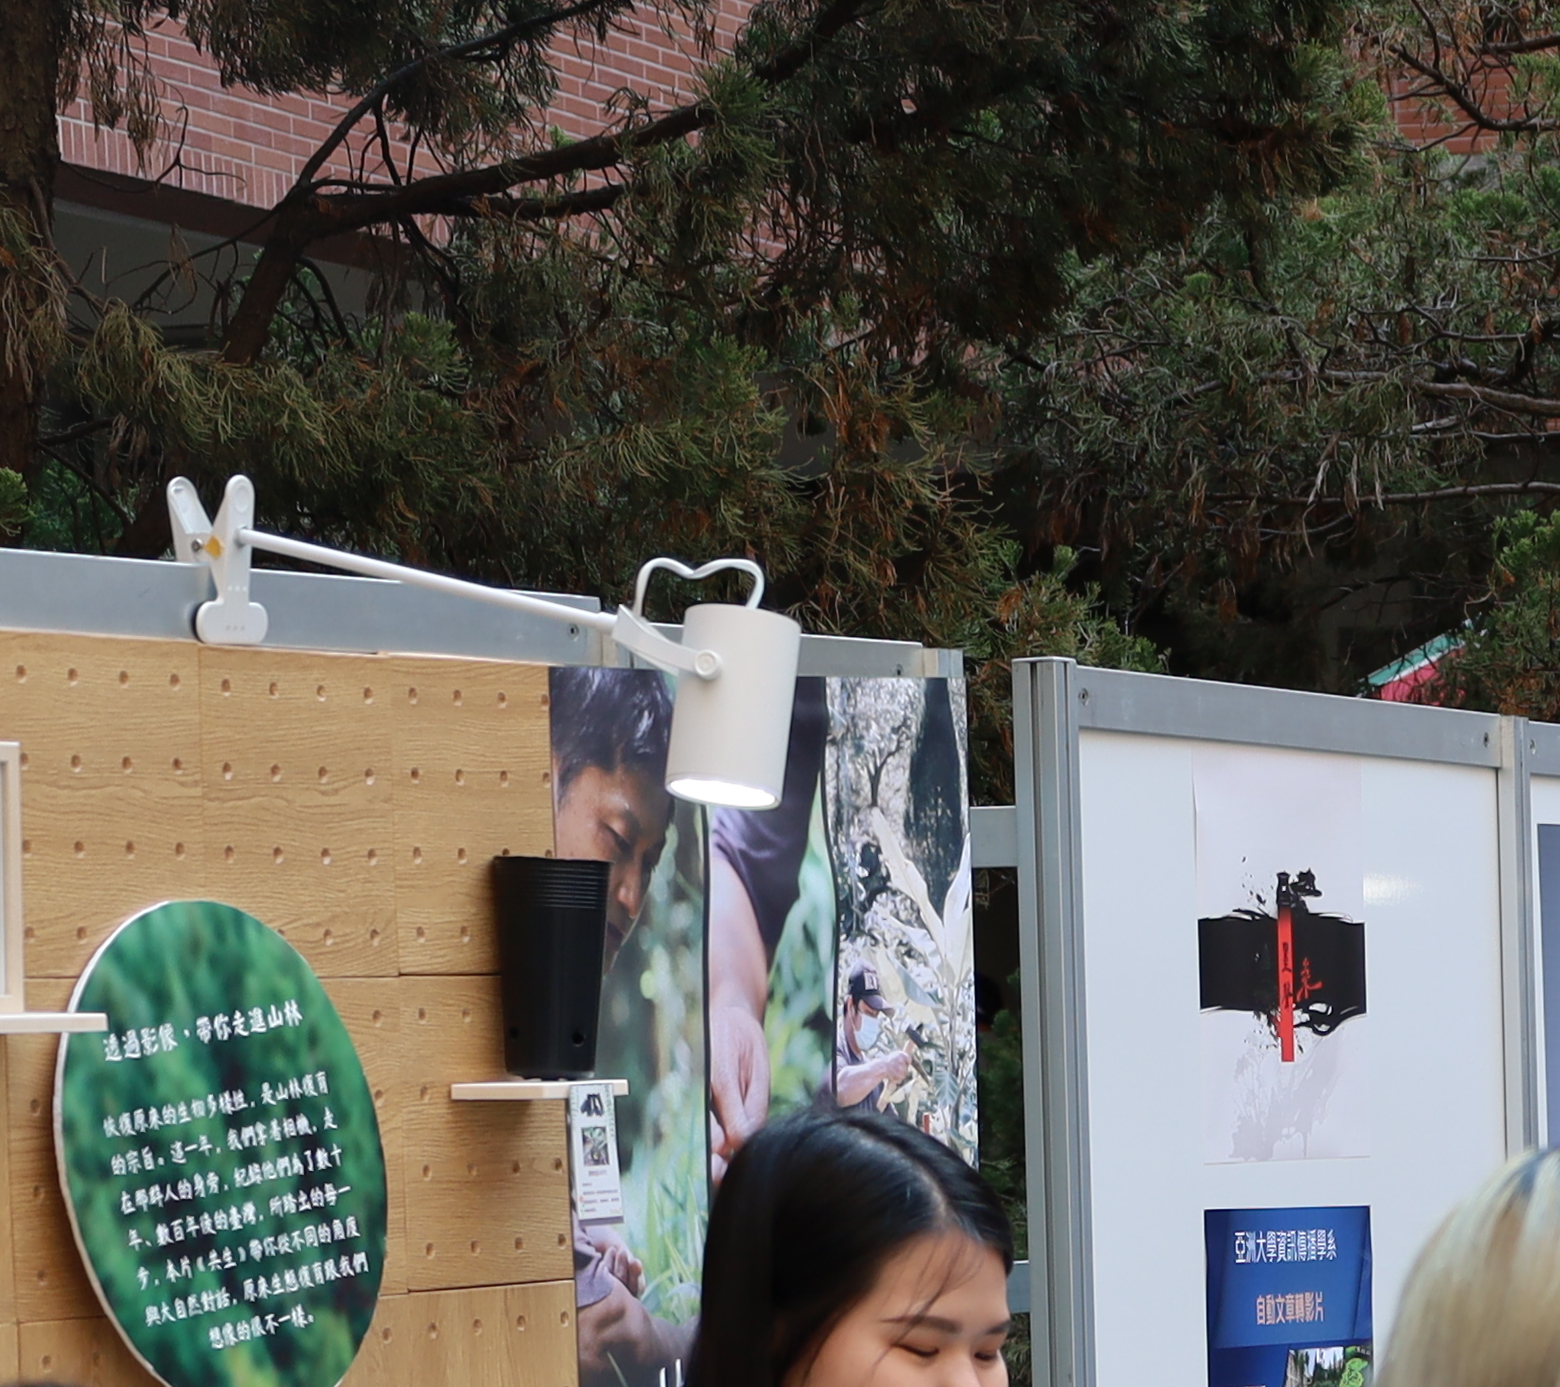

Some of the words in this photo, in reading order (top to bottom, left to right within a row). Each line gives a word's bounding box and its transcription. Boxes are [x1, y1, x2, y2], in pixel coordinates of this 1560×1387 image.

[1234, 1229, 1338, 1264] 亞洲大學資訊傳播學系
[1256, 1291, 1325, 1326] 自動文章轉影片
